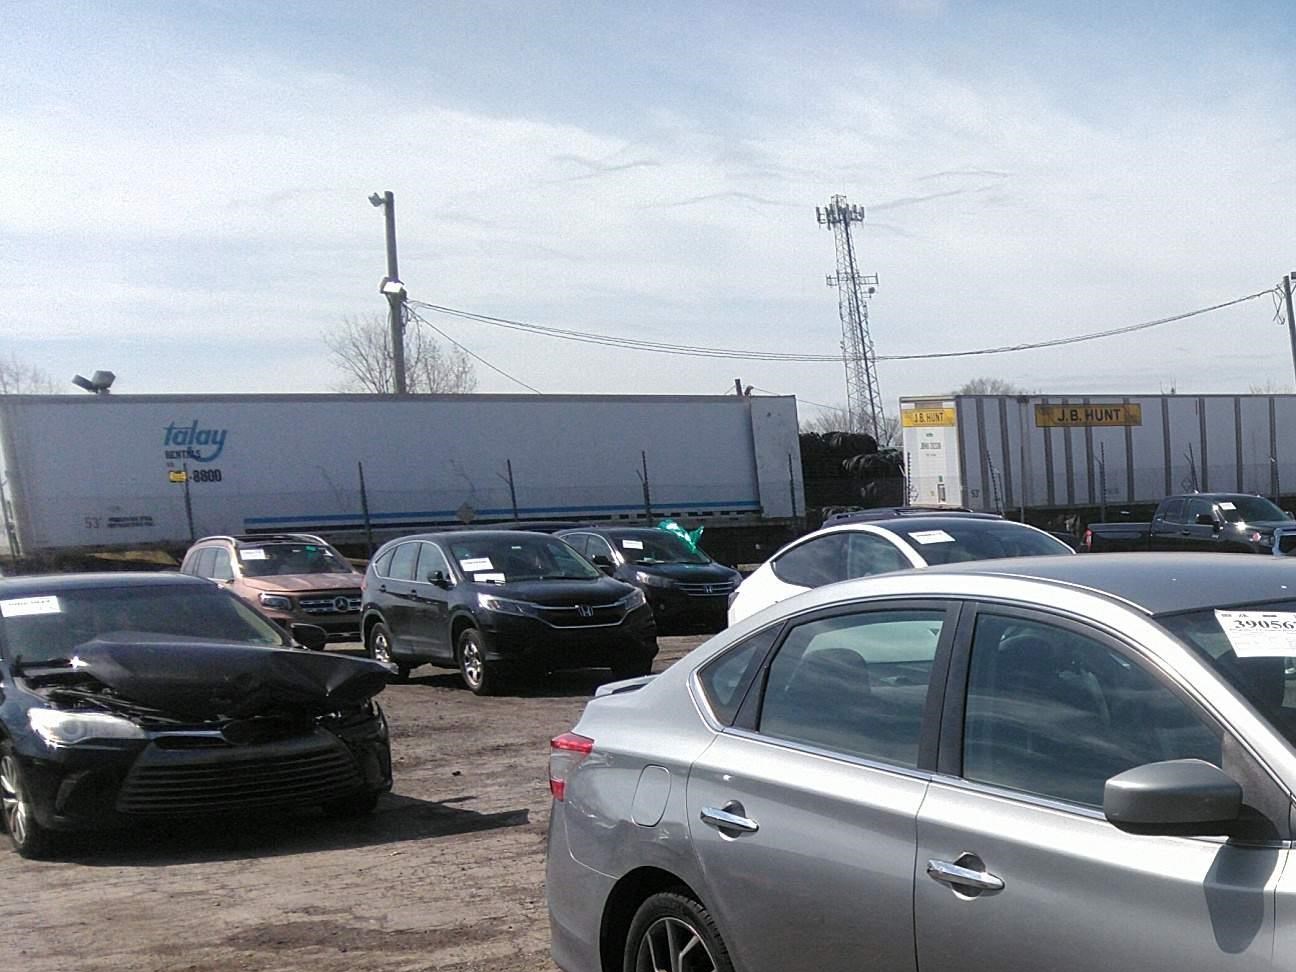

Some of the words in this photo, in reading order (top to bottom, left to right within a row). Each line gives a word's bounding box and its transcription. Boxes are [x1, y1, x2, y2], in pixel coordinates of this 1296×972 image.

[927, 412, 944, 422] HUNT
[1057, 409, 1082, 422] J.B.
[1085, 408, 1121, 421] HUNT
[163, 420, 228, 462] talay
